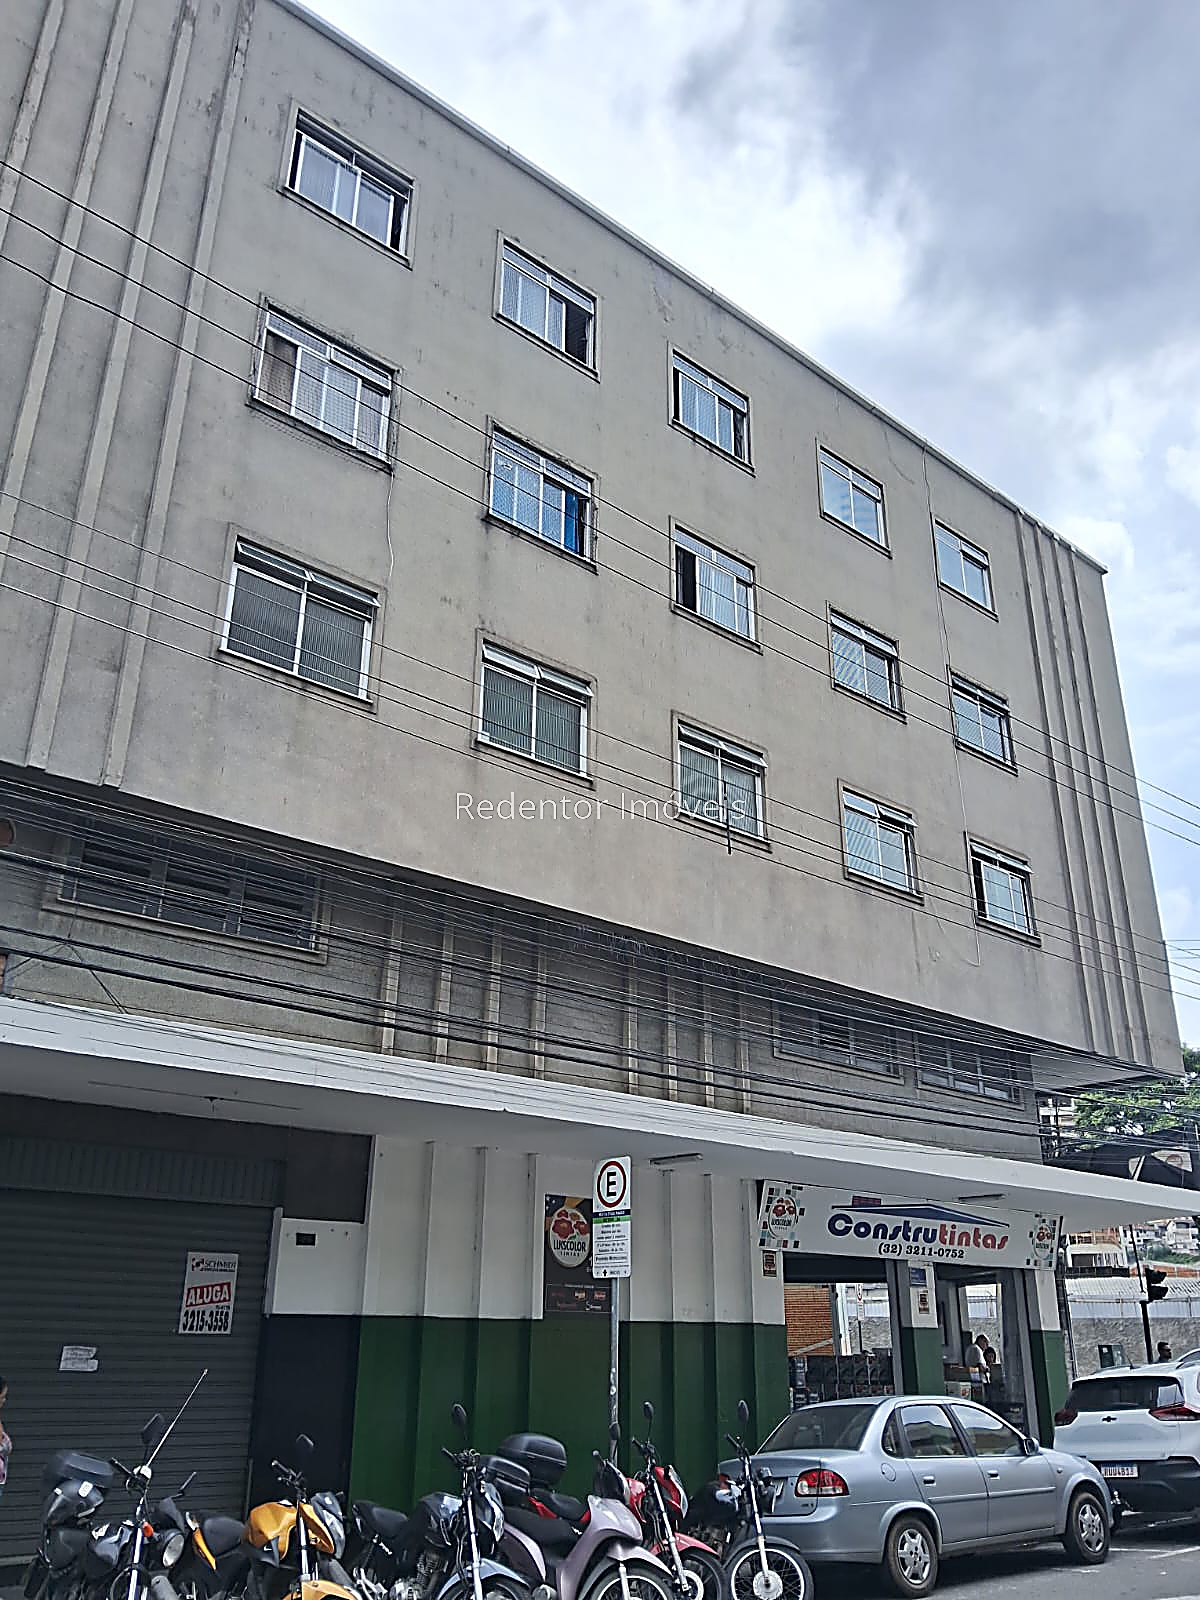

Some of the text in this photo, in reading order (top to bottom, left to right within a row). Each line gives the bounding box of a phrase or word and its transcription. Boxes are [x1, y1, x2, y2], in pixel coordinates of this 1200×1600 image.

[606, 1171, 617, 1198] E
[827, 1213, 1009, 1250] Construtintas
[553, 1240, 586, 1252] LUKSCOLOR
[878, 1242, 965, 1259] (32) 3211-0752
[186, 1284, 230, 1306] ALUGA
[182, 1309, 230, 1332] 3215-3558
